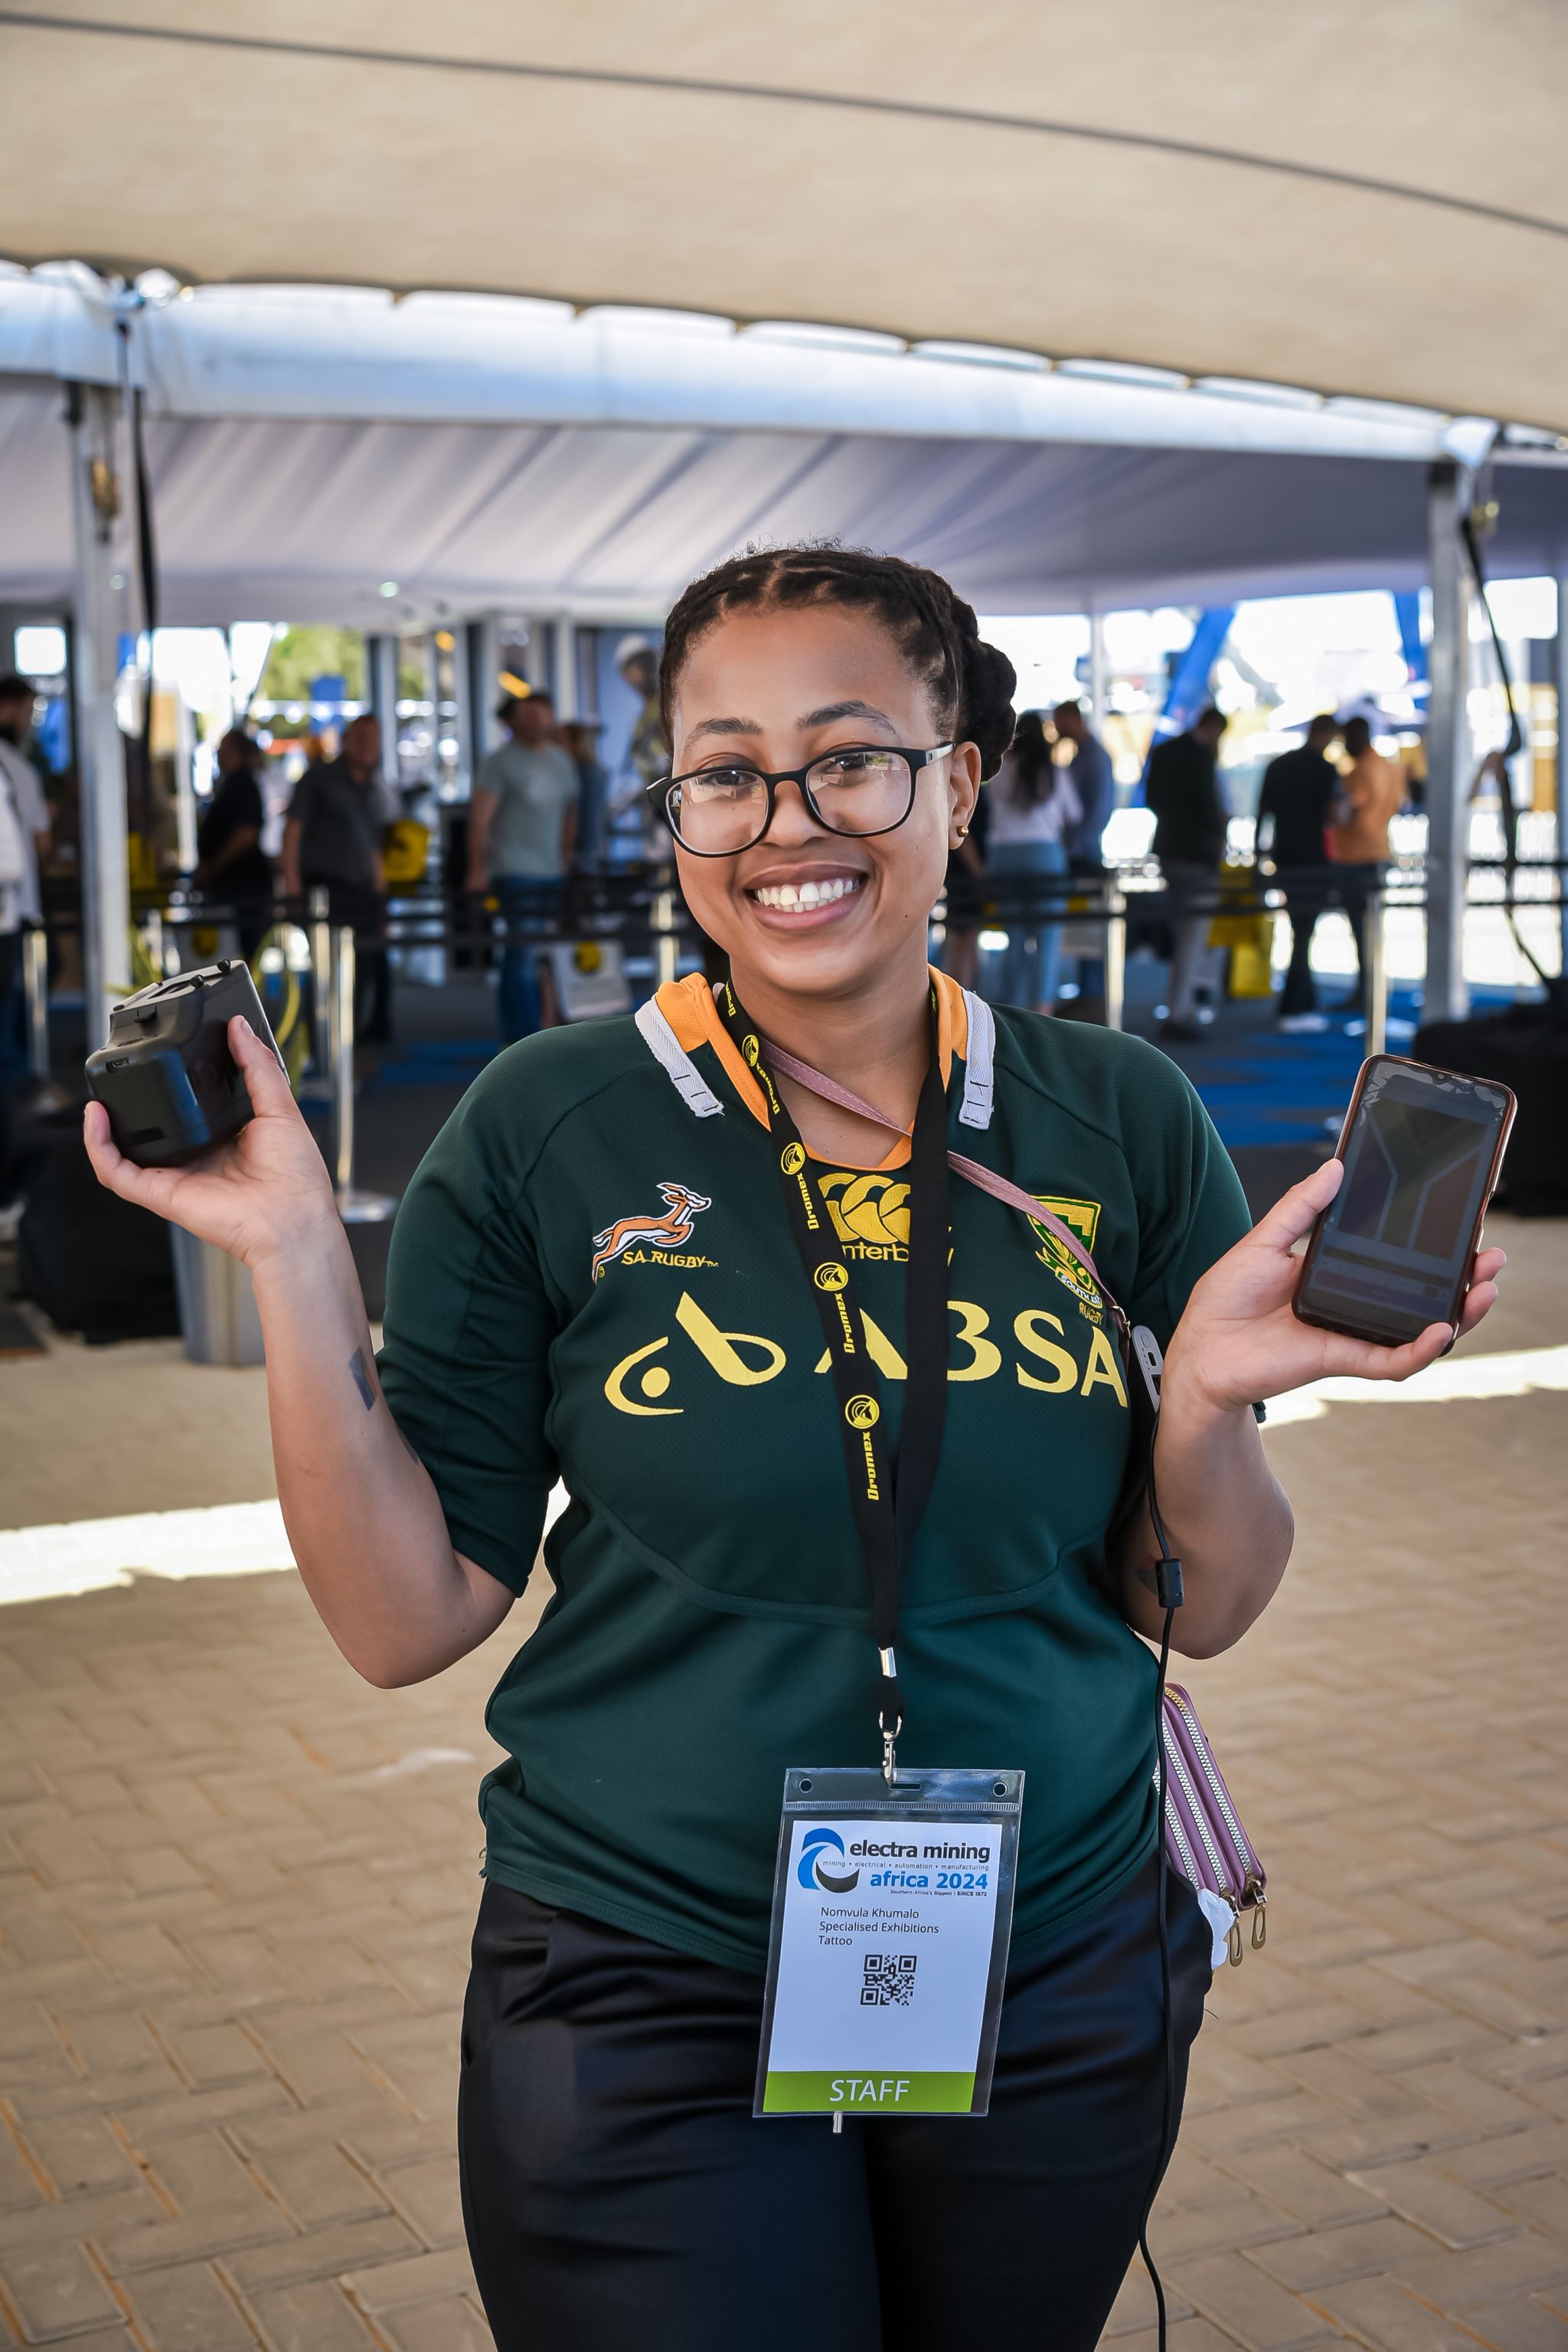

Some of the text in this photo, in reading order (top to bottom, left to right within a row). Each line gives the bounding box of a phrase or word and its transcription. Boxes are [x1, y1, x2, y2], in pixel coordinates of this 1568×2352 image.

[756, 1062, 781, 1116] Dromex
[796, 1172, 820, 1230] Dromex
[621, 1250, 646, 1266] SA
[834, 1292, 856, 1354] Dromex
[1079, 1302, 1103, 1326] RUGBY
[862, 1431, 880, 1501] Dromex
[850, 1839, 990, 1864] electra mining
[870, 1870, 988, 1890] africa 2024
[821, 1906, 920, 1919] Nomvula Khumalo
[819, 1921, 939, 1934] Specialised Exhibitions
[818, 1936, 853, 1945] Tattoo
[829, 2079, 910, 2102] STAFF
